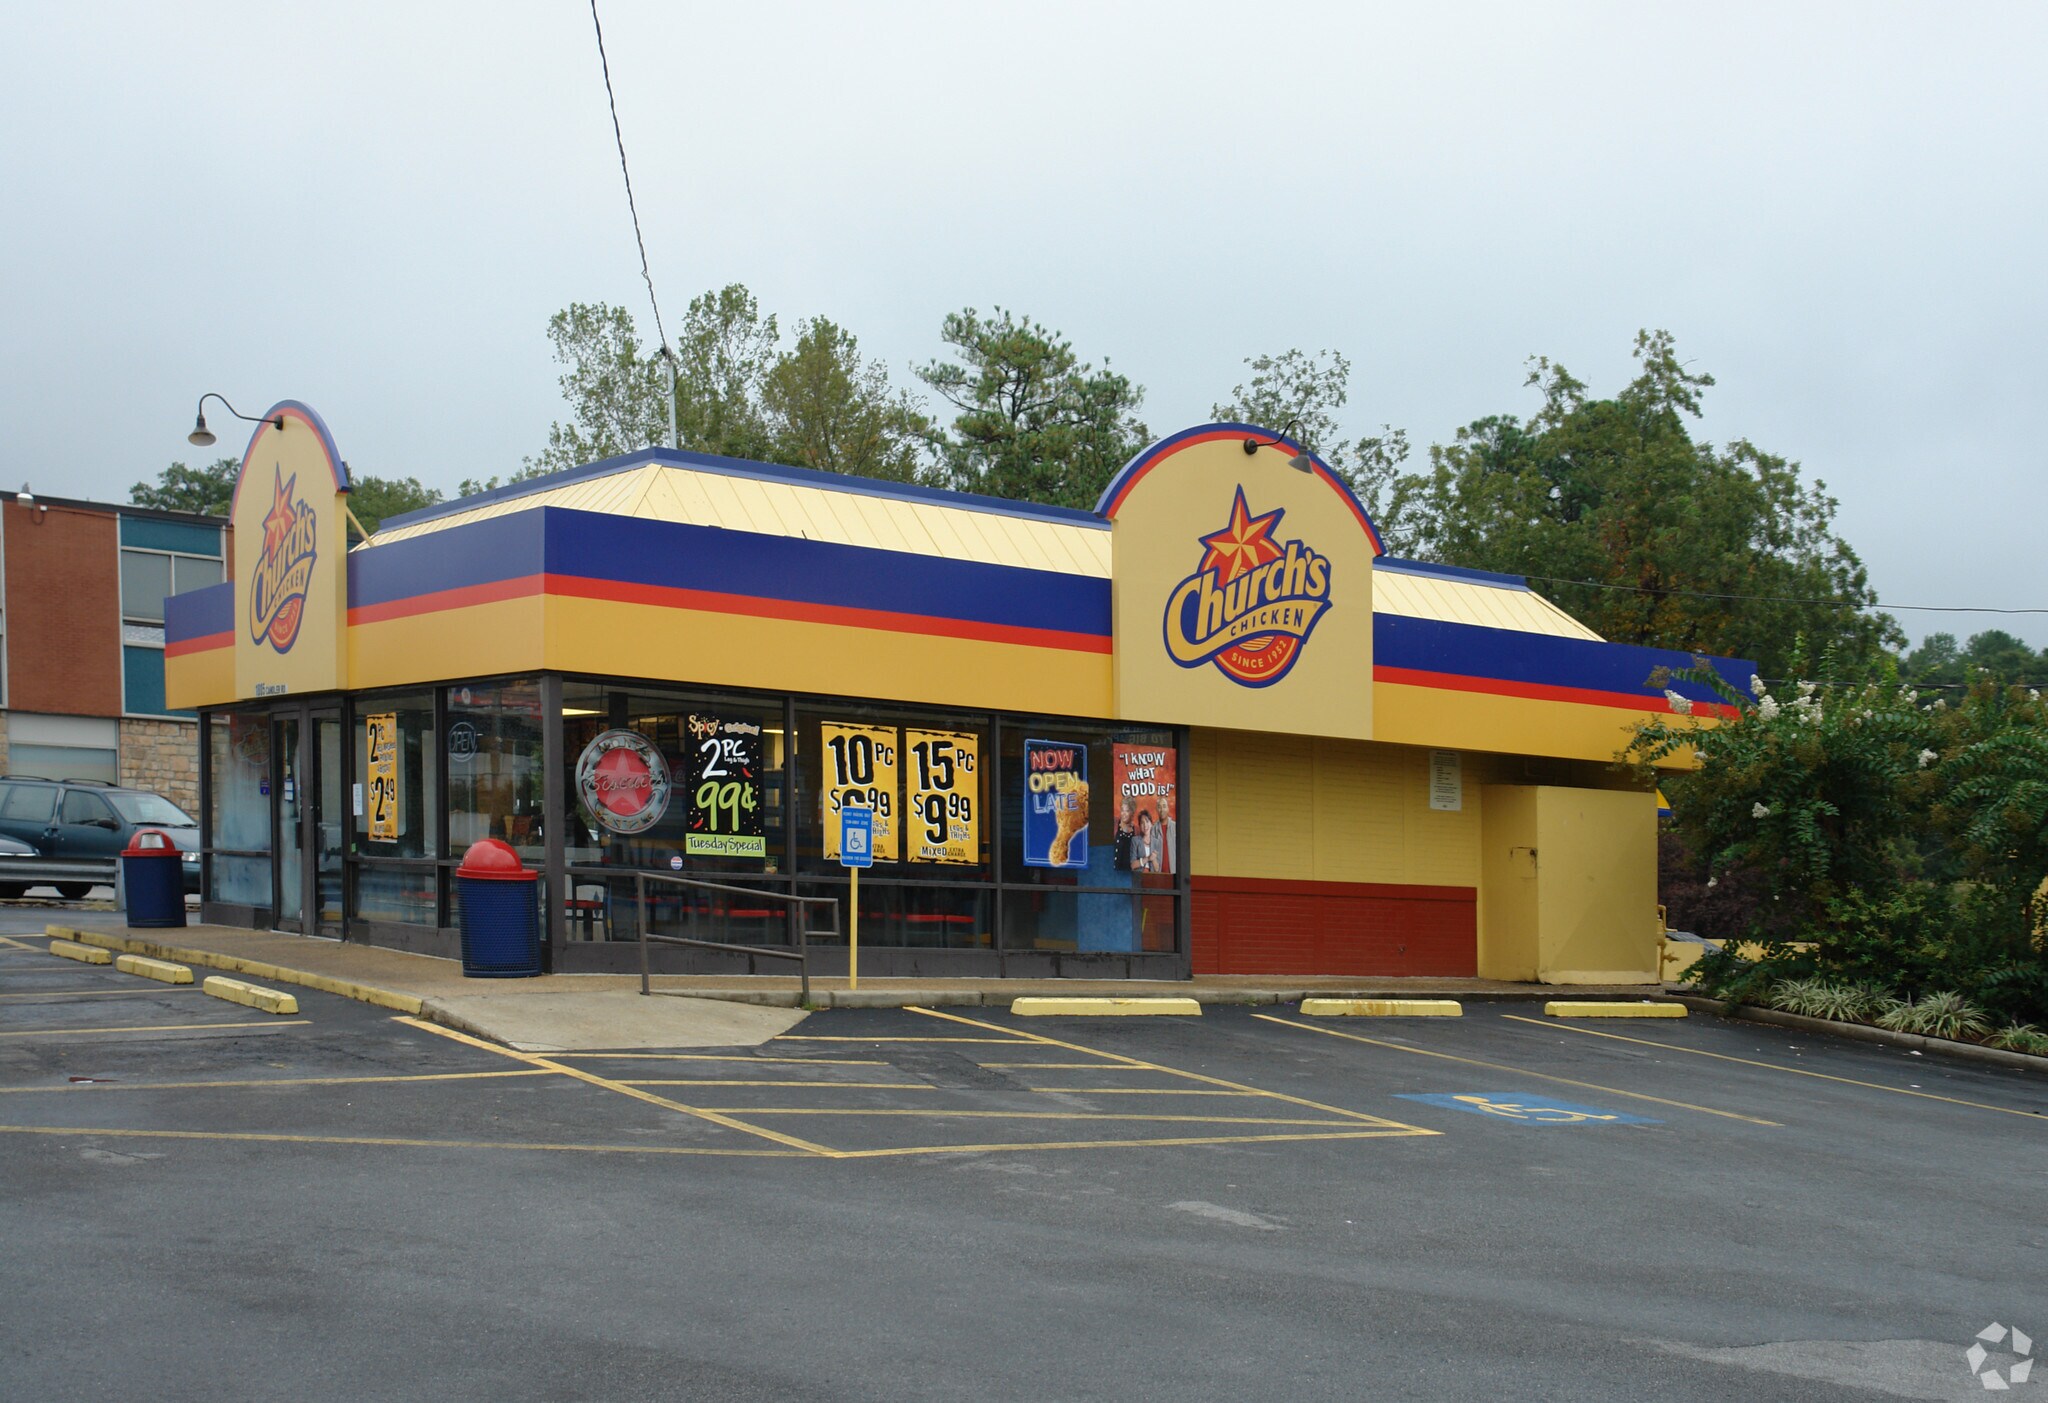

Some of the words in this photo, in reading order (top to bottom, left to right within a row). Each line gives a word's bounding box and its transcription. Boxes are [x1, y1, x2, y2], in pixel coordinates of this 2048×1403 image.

[251, 500, 316, 642] Church's
[273, 566, 305, 608] CHICKEN
[1165, 542, 1327, 663] Church's
[1229, 607, 1304, 637] CHICKEN
[1231, 651, 1264, 669] SINCE
[1267, 639, 1287, 664] 1952
[369, 722, 379, 763] 2
[688, 714, 720, 740] Spicy
[701, 738, 728, 779] 2
[721, 739, 747, 757] PC
[827, 734, 874, 786] 10
[874, 742, 894, 768] PC
[911, 740, 955, 792] 15
[955, 748, 974, 773] PC
[1030, 749, 1074, 771] NOW
[1028, 771, 1079, 793] OPEN
[1121, 781, 1156, 797] GOOD
[696, 781, 757, 832] 99¢
[1032, 792, 1079, 814] LATE
[688, 836, 728, 854] Tuesday
[727, 837, 763, 855] Special
